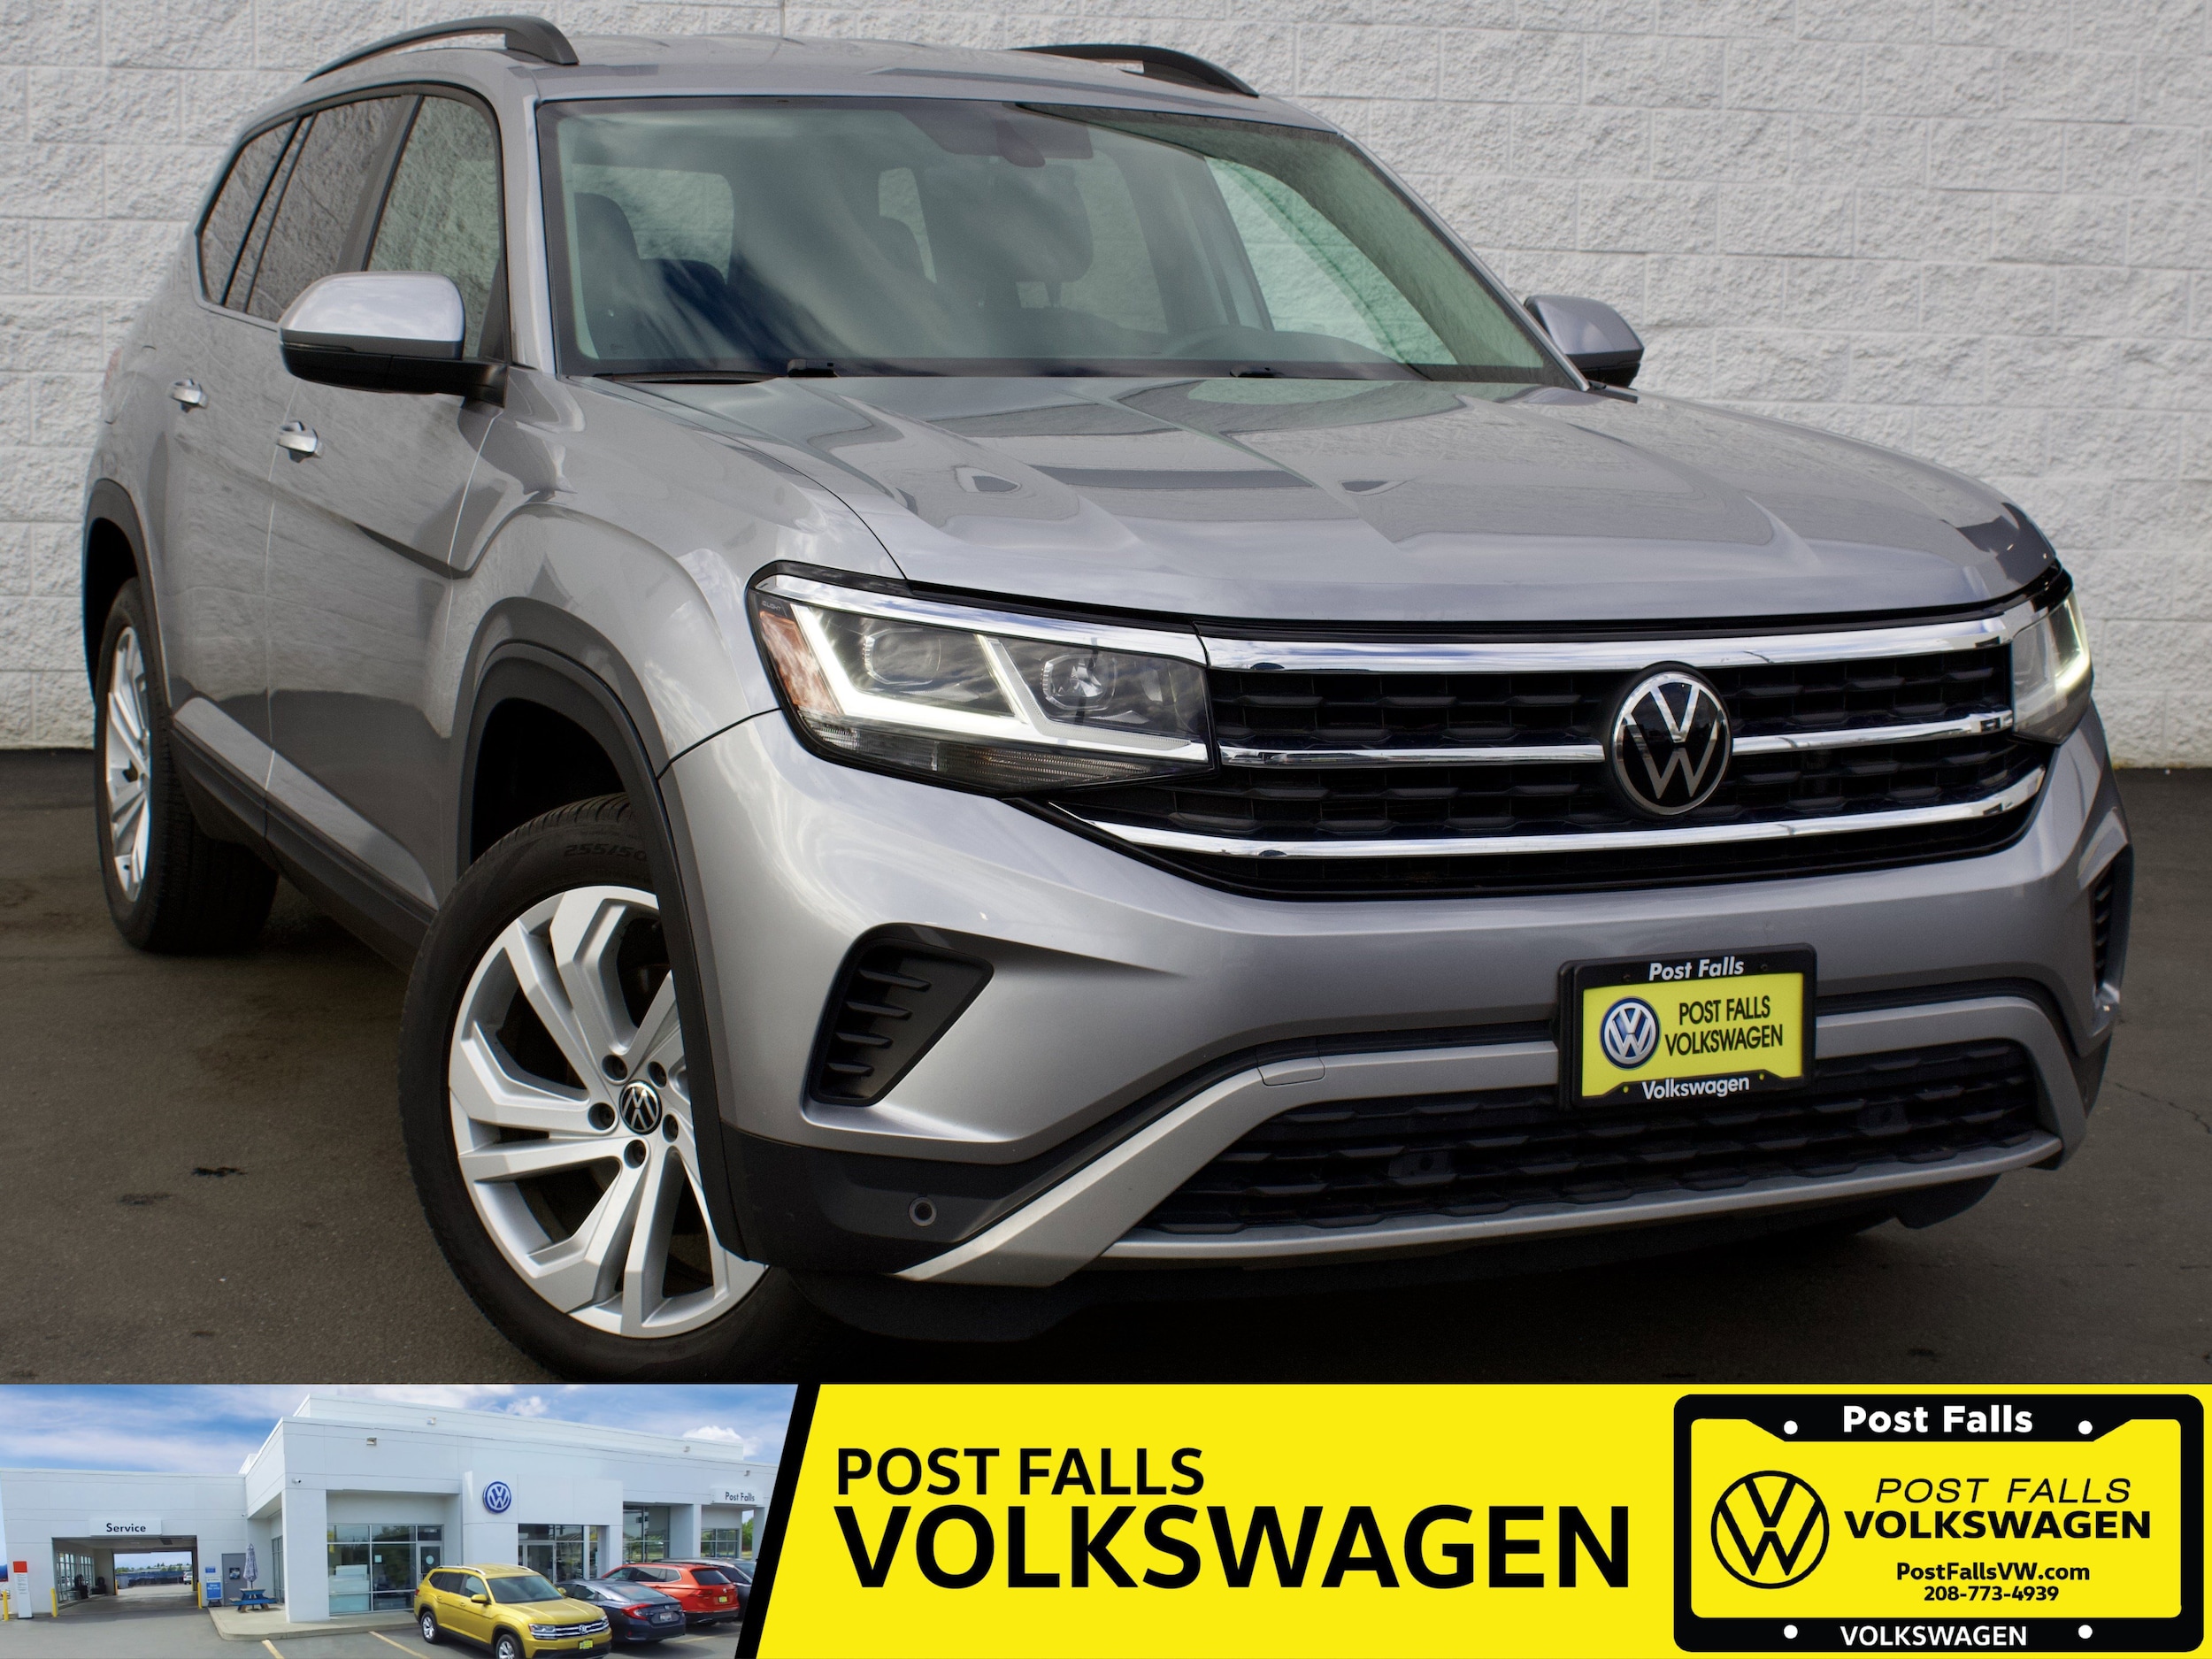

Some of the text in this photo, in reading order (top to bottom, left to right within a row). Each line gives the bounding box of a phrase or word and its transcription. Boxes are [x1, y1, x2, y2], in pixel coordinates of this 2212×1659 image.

[1614, 671, 1730, 815] VW
[1648, 956, 1745, 981] Post Falls
[1678, 995, 1771, 1025] POST FALLS
[1599, 996, 1661, 1071] VW
[1664, 1024, 1784, 1056] VOLKSWAGEN
[1642, 1076, 1750, 1101] Volkswagen
[483, 1481, 511, 1514] VW
[725, 1491, 756, 1502] Post Falls
[106, 1522, 147, 1532] Service
